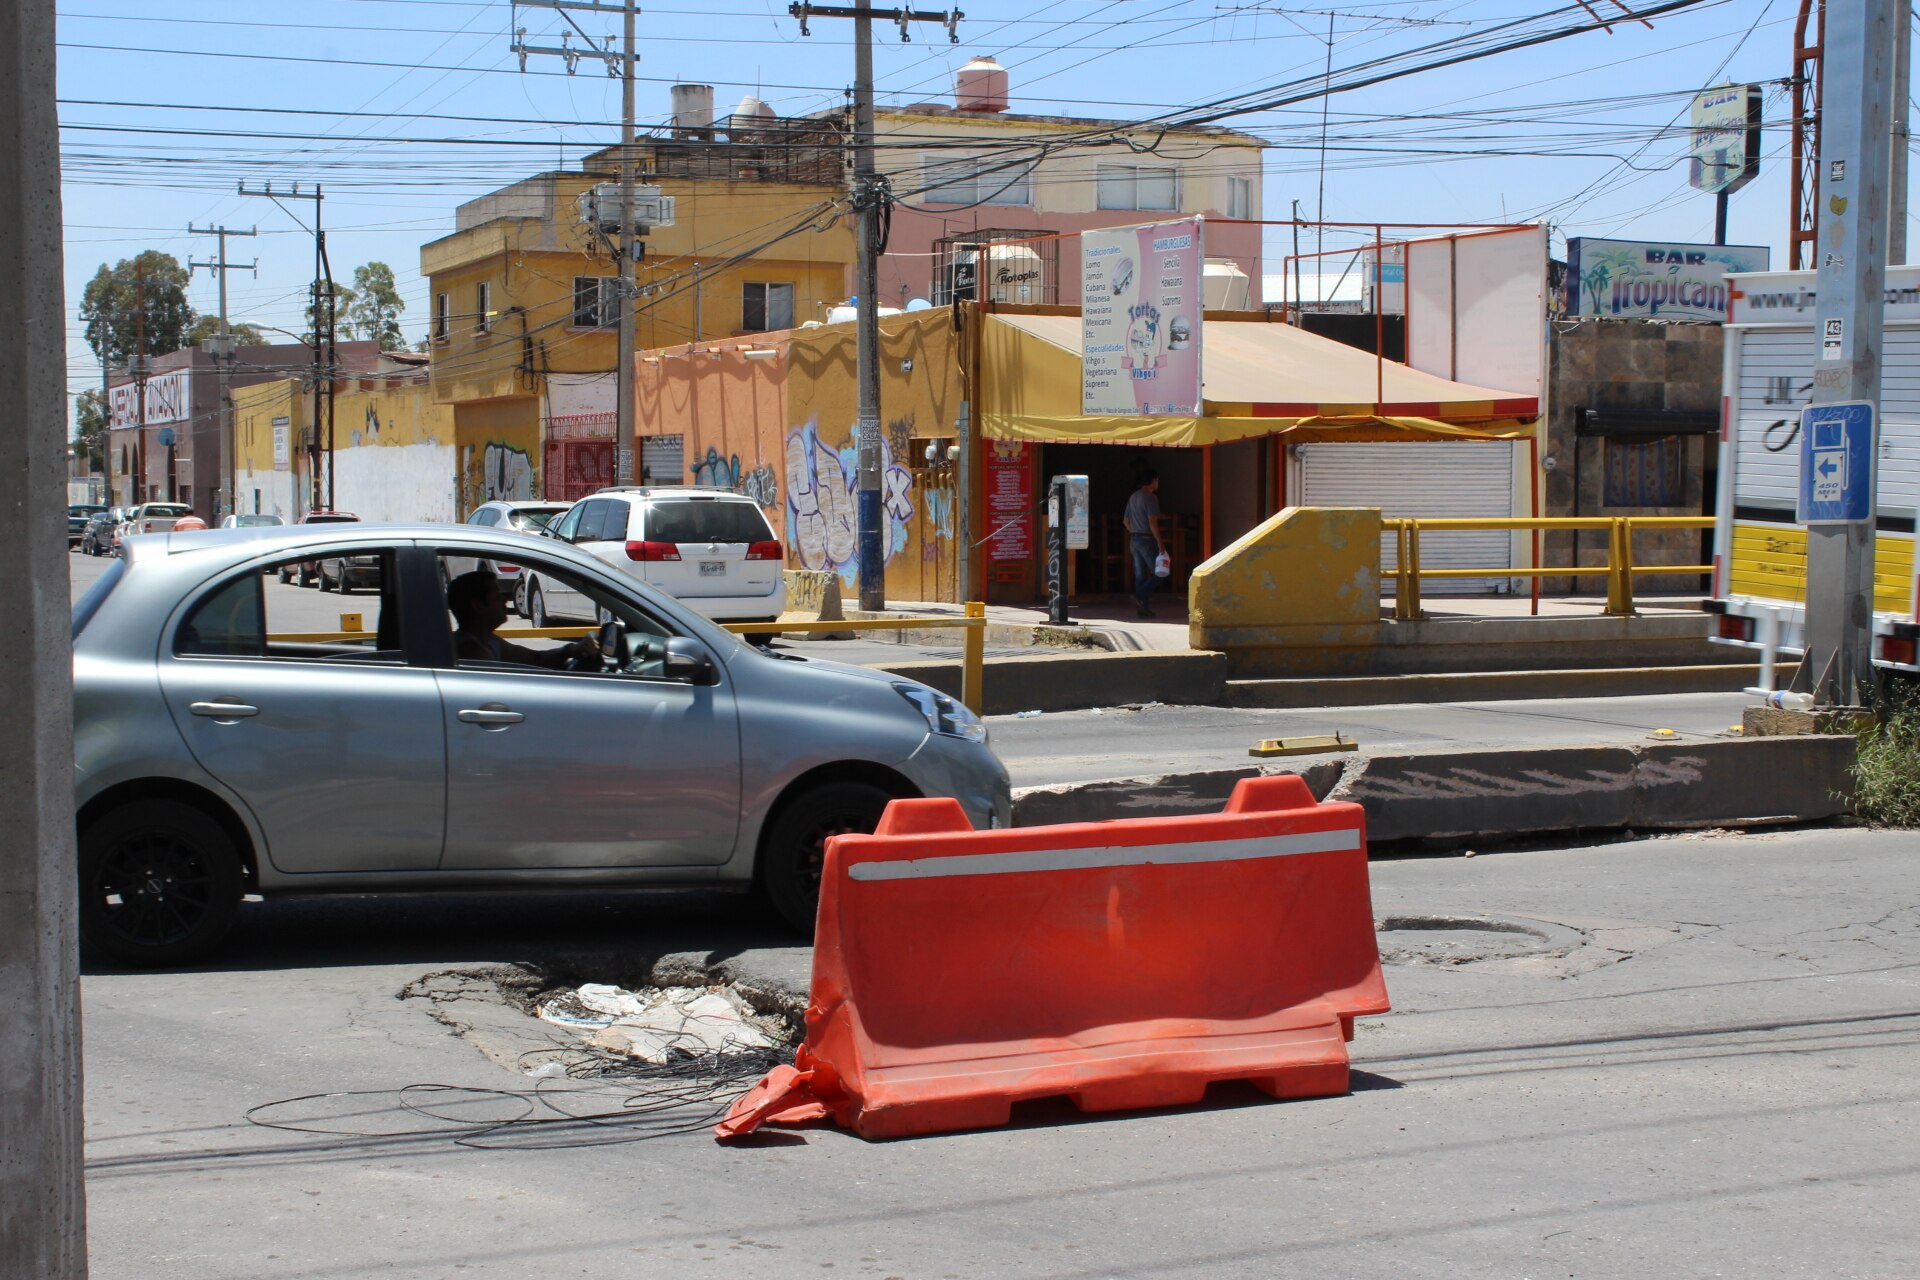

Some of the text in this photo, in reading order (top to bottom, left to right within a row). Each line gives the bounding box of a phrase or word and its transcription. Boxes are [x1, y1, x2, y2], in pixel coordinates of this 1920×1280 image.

[1703, 91, 1738, 109] BAR
[1154, 236, 1191, 251] HAMBURGUESAS
[1085, 246, 1121, 257] Tradicionales
[1646, 248, 1706, 265] BAR
[1085, 261, 1101, 269] Lomo
[1163, 255, 1180, 269] Sencilla
[1000, 270, 1039, 284] Rotoplas
[1085, 283, 1106, 292] Cubana
[1607, 267, 1728, 315] Tropican
[1085, 295, 1111, 304] Milanesa
[1162, 295, 1181, 307] Suprema
[1085, 307, 1112, 316] Hawaiana
[1128, 301, 1161, 324] Tortas
[1085, 318, 1112, 327] Mexicana
[1085, 330, 1096, 339] Etc.
[1085, 344, 1125, 354] Especialidades
[1085, 368, 1118, 378] Vegetariana
[1085, 379, 1110, 389] Suprema
[1085, 391, 1096, 400] Etc.
